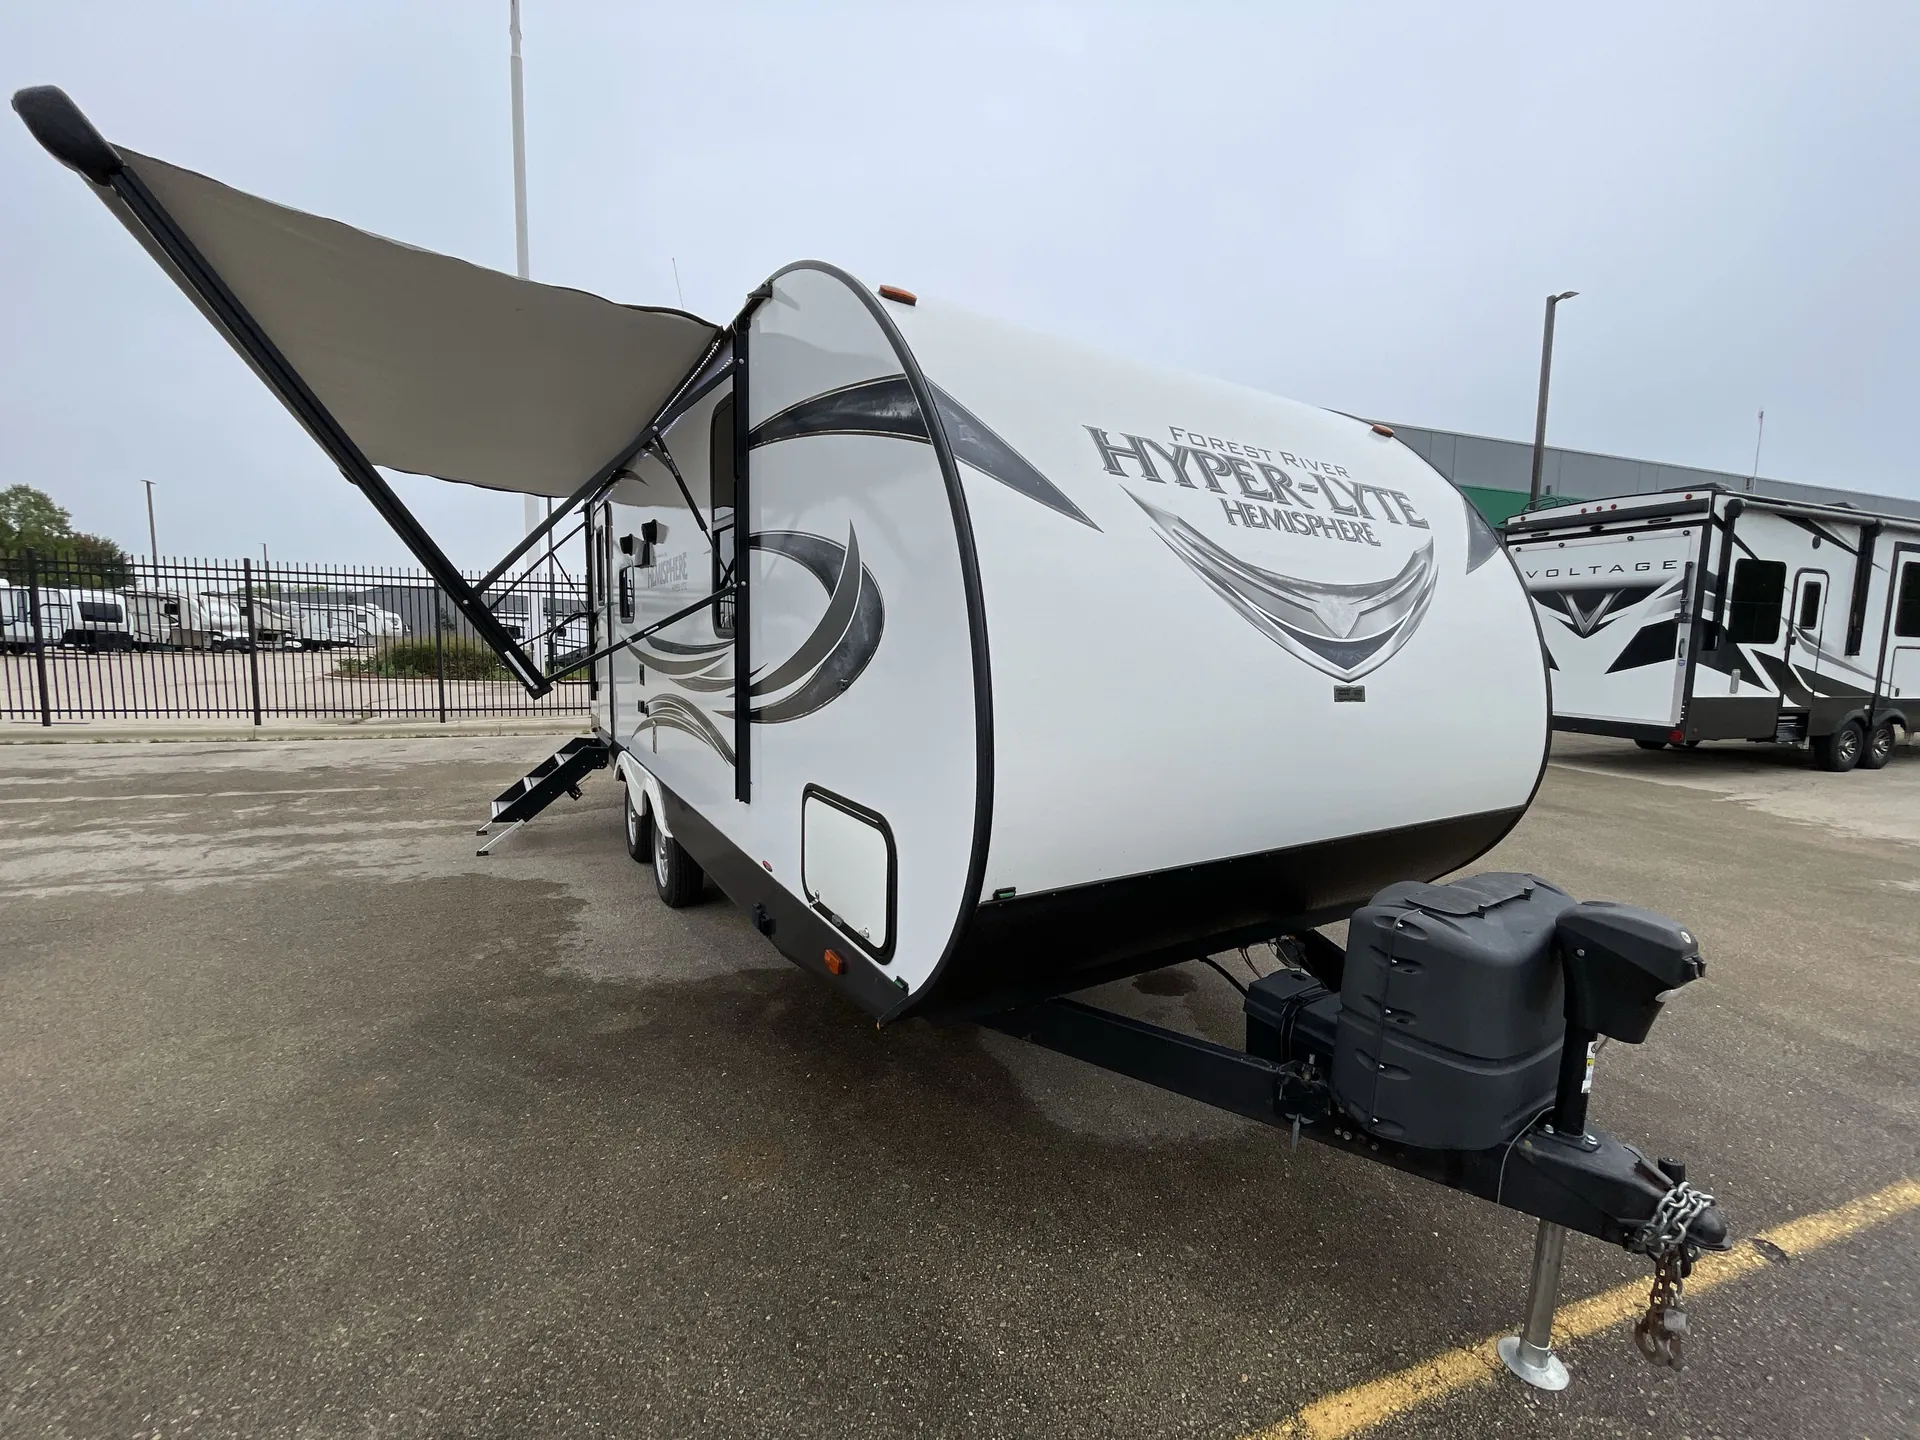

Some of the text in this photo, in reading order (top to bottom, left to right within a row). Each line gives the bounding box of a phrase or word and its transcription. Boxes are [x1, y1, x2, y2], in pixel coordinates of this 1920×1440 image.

[1082, 424, 1431, 531] HYPER-LYTE
[1168, 425, 1351, 479] FOREST RIVER
[1218, 497, 1382, 547] HEMISPHERE
[1525, 559, 1678, 579] VOLTAGE
